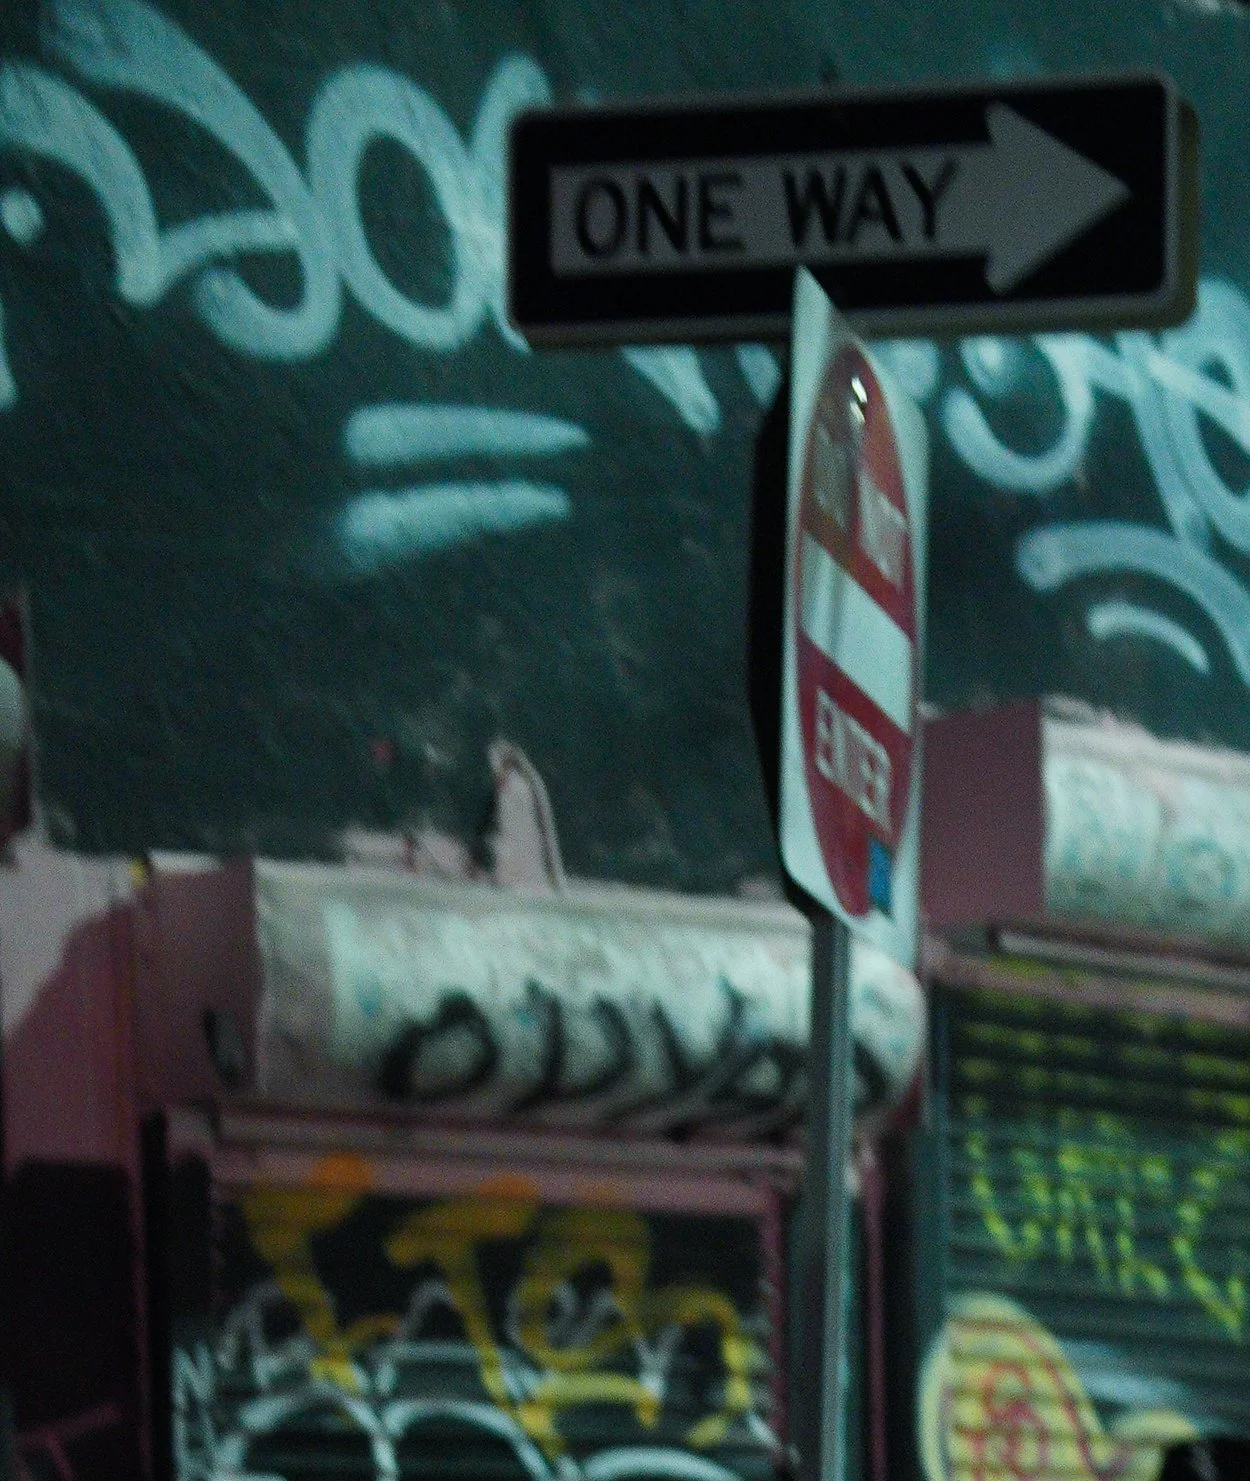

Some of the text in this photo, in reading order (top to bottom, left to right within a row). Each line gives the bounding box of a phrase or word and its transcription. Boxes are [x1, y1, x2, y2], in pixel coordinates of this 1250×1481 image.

[574, 157, 958, 259] ONE WAY
[815, 686, 895, 836] ENTER
